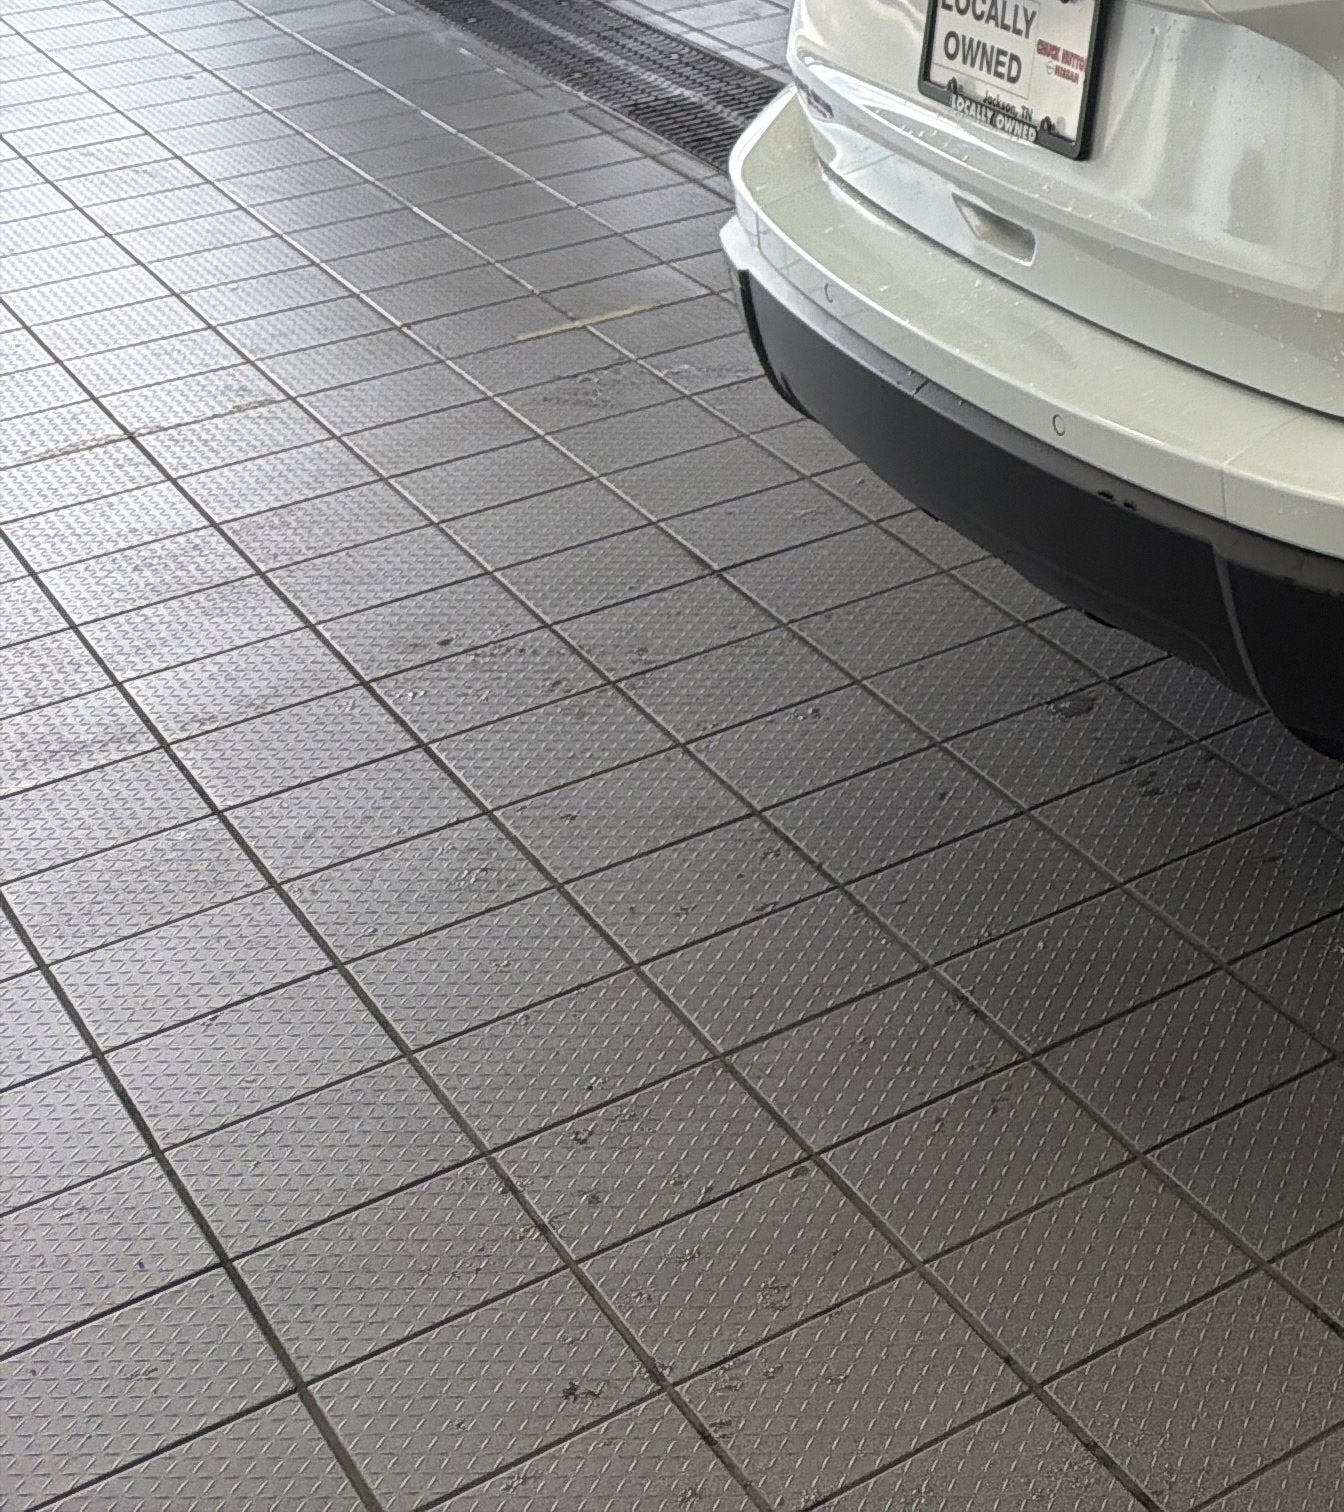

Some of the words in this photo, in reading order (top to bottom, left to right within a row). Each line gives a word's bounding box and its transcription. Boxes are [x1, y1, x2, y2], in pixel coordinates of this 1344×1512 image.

[943, 30, 1022, 85] OWNED
[1054, 64, 1079, 85] NISSAN
[951, 93, 993, 125] LOCALLY
[995, 114, 1038, 142] OWNED
[983, 90, 1018, 117] Jackson,
[1021, 105, 1033, 123] TN
